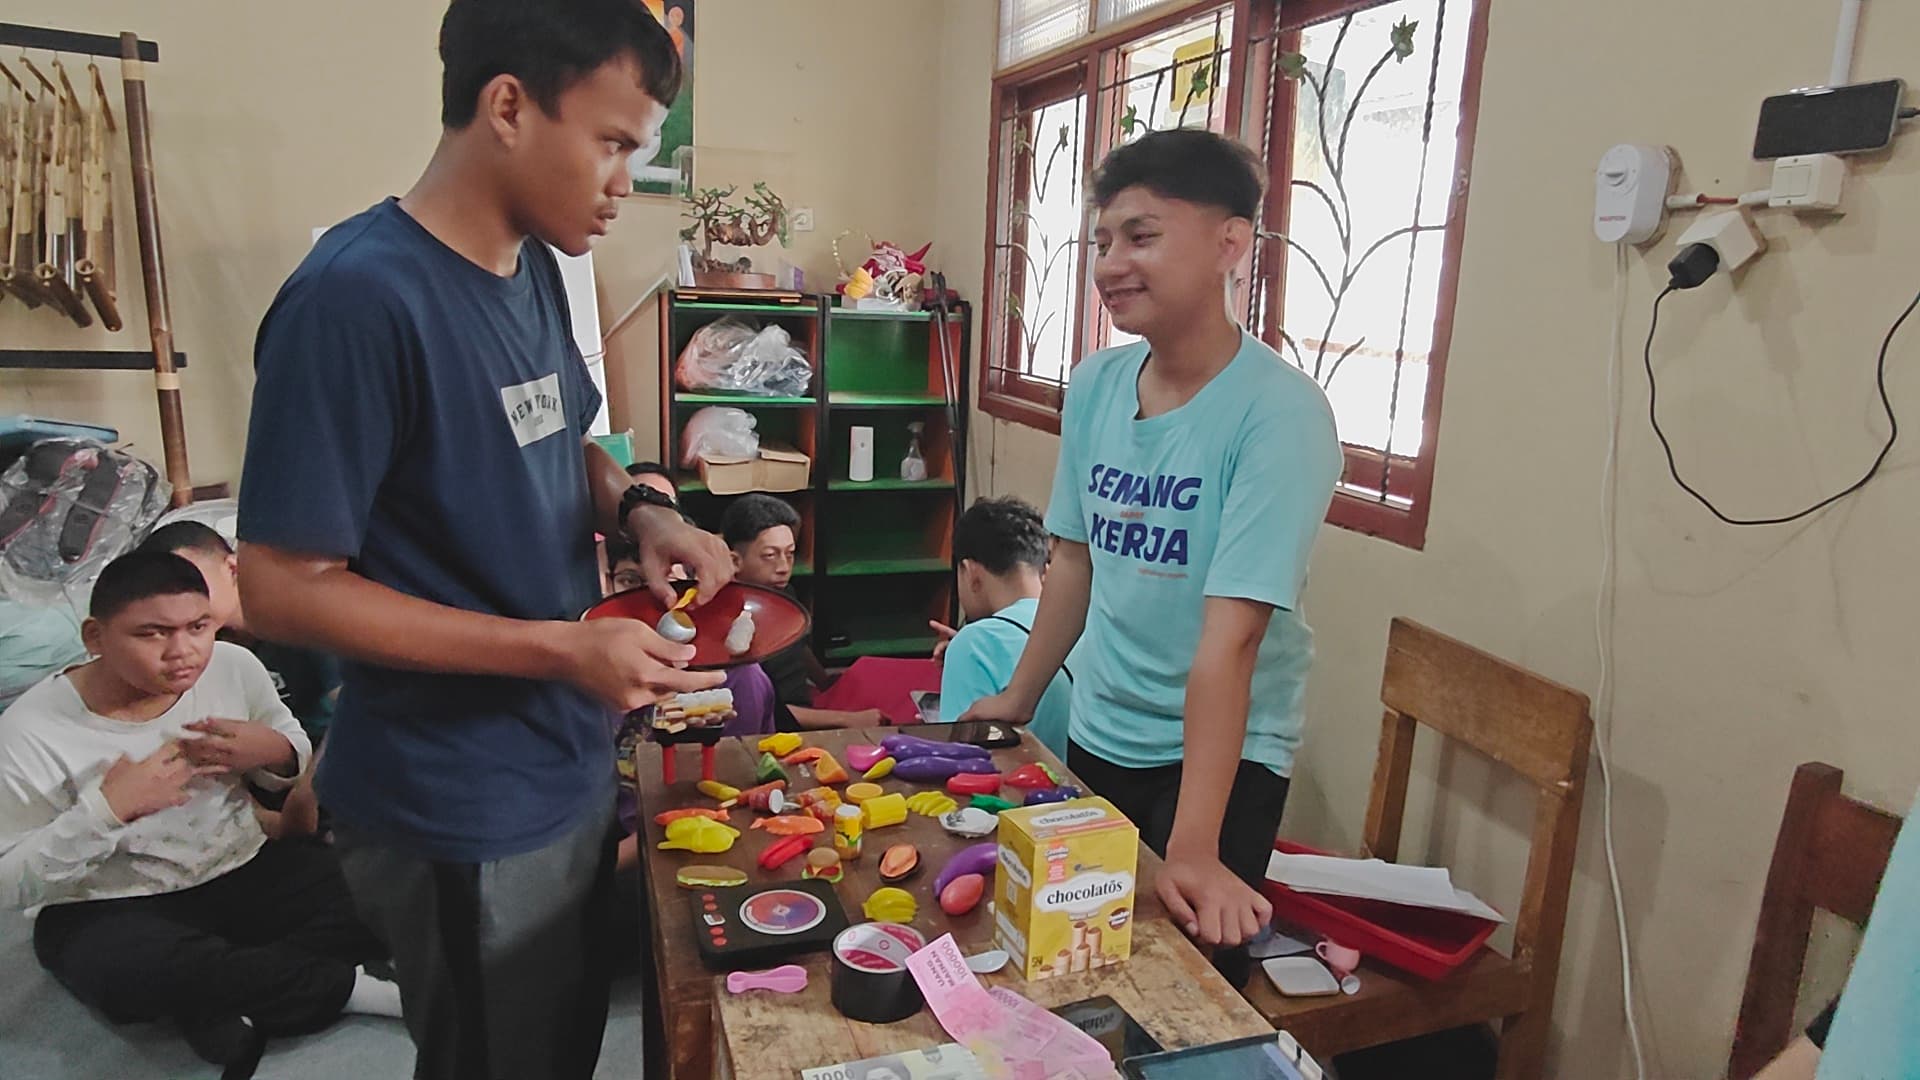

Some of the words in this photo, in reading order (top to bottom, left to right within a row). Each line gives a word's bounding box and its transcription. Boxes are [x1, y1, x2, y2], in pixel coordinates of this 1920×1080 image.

[1088, 463, 1203, 511] SENANG
[1090, 512, 1188, 566] KERJA
[927, 960, 945, 987] UANG
[931, 951, 955, 986] MAINAN
